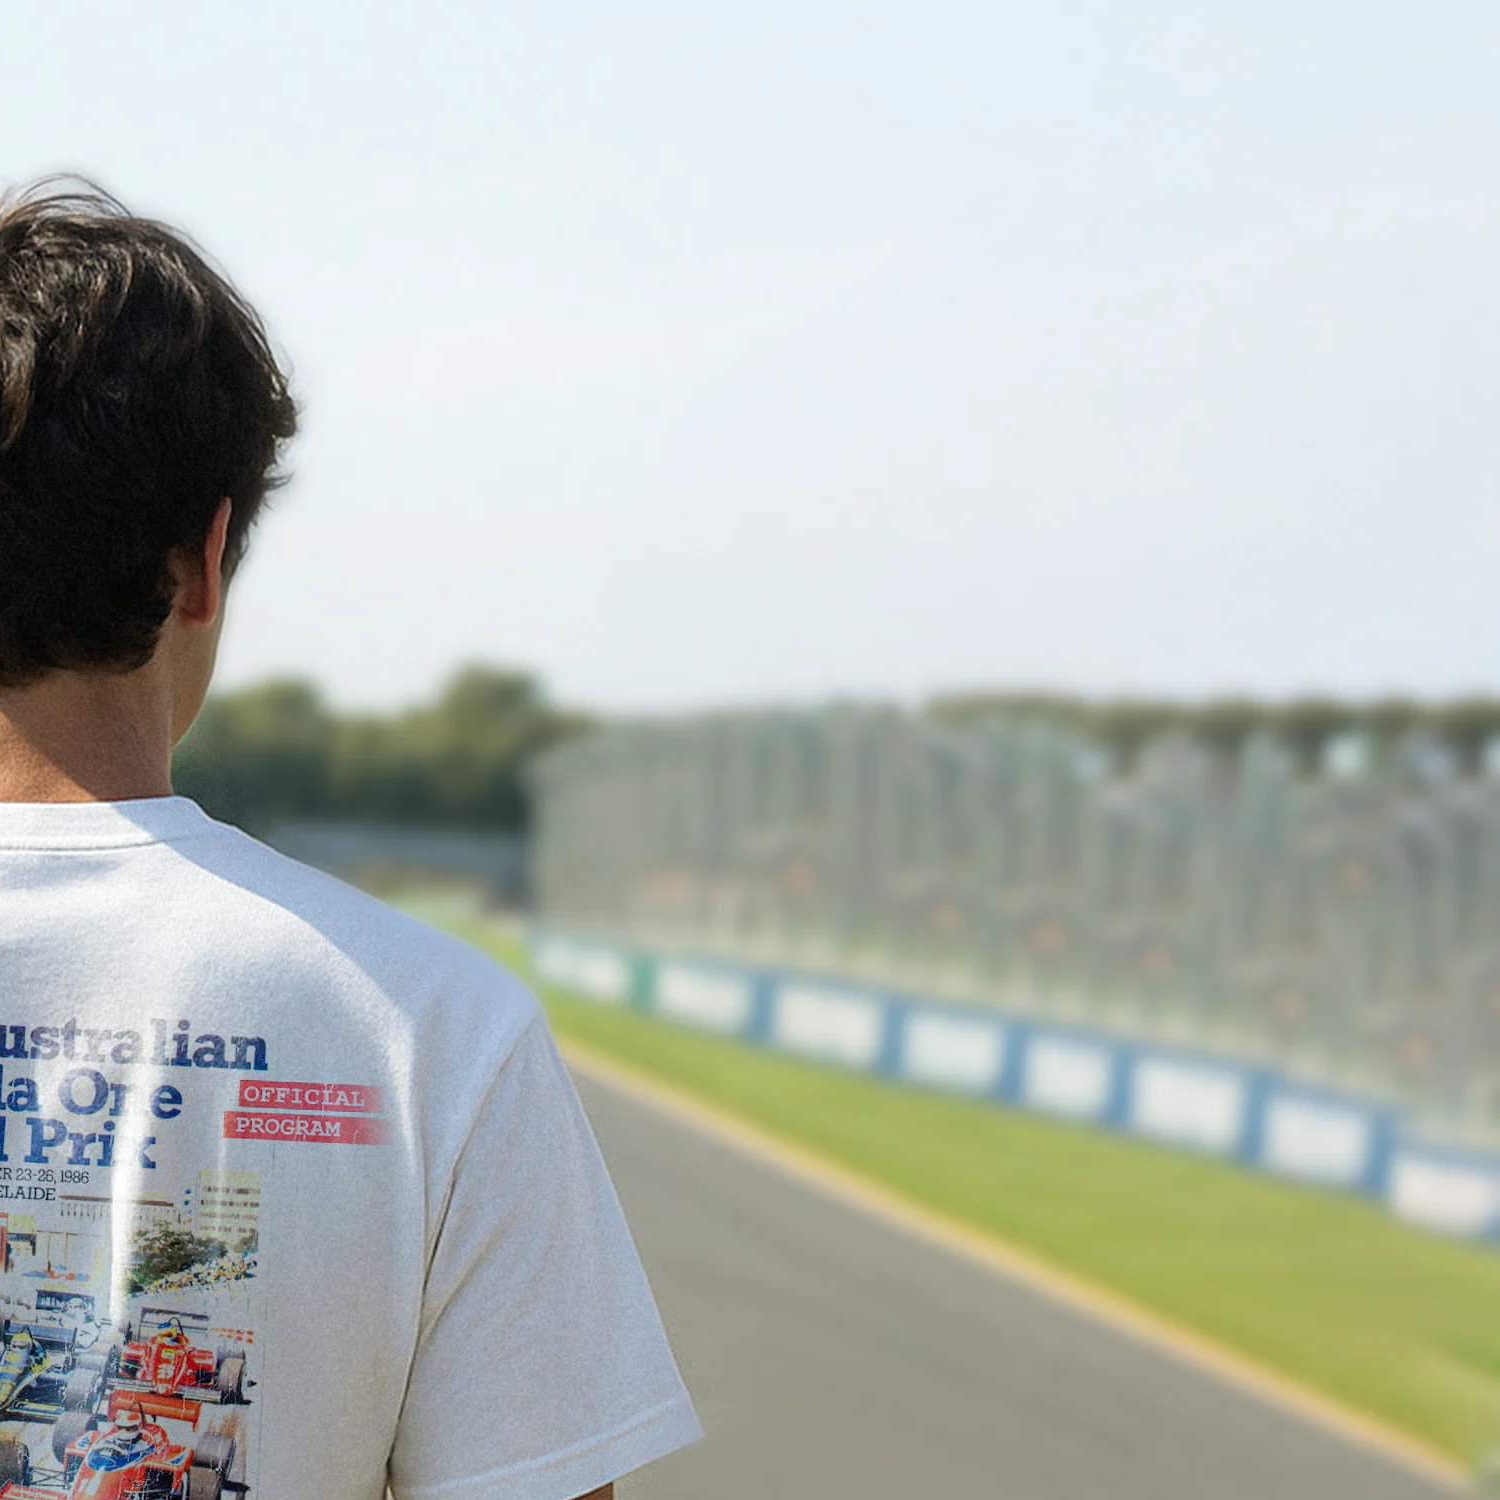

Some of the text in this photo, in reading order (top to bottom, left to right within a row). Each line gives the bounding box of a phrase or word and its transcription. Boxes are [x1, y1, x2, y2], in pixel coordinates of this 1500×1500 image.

[243, 1085, 366, 1108] OFFICIAL
[235, 1116, 342, 1138] PROGRAM
[15, 1168, 57, 1185] 23-26,
[60, 1169, 90, 1185] 1986
